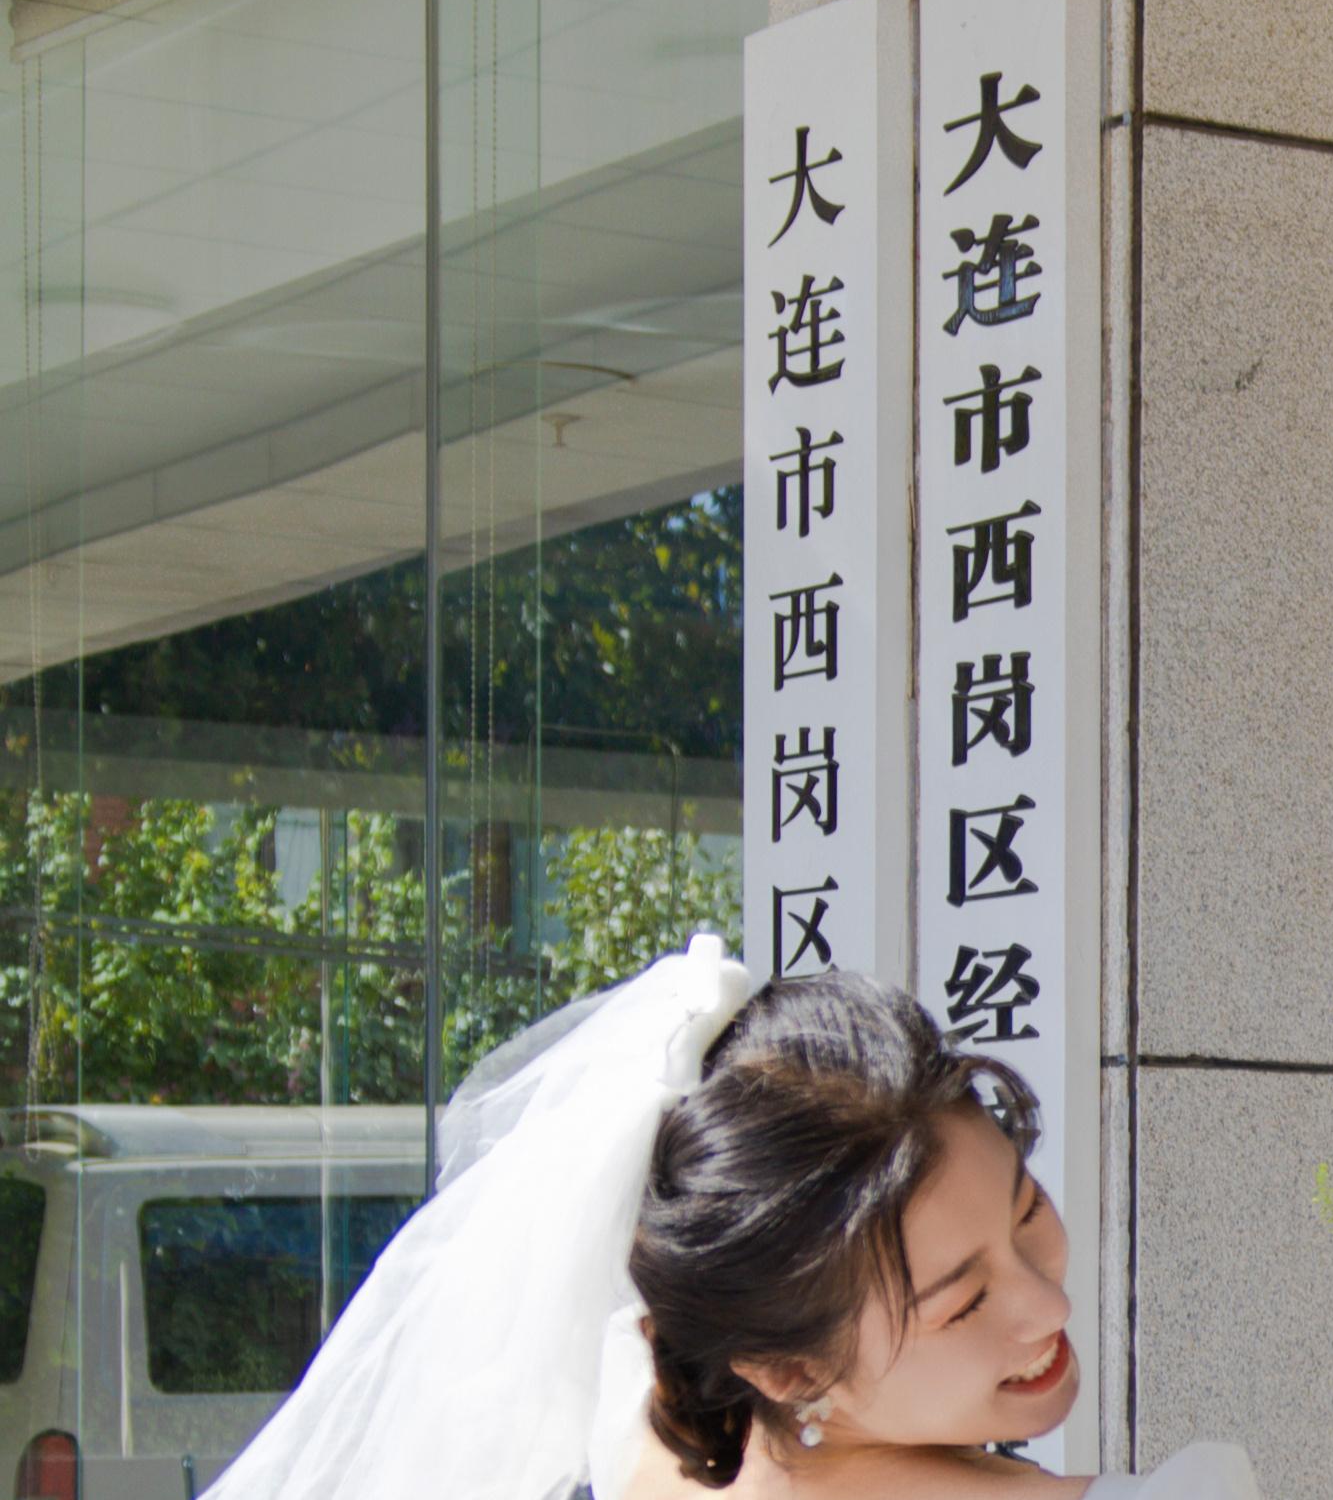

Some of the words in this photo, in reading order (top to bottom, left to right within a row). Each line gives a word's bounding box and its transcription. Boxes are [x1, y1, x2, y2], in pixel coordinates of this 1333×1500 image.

[767, 126, 846, 983] 大连市西岗区
[942, 71, 1043, 1155] 大连市西岗区经
